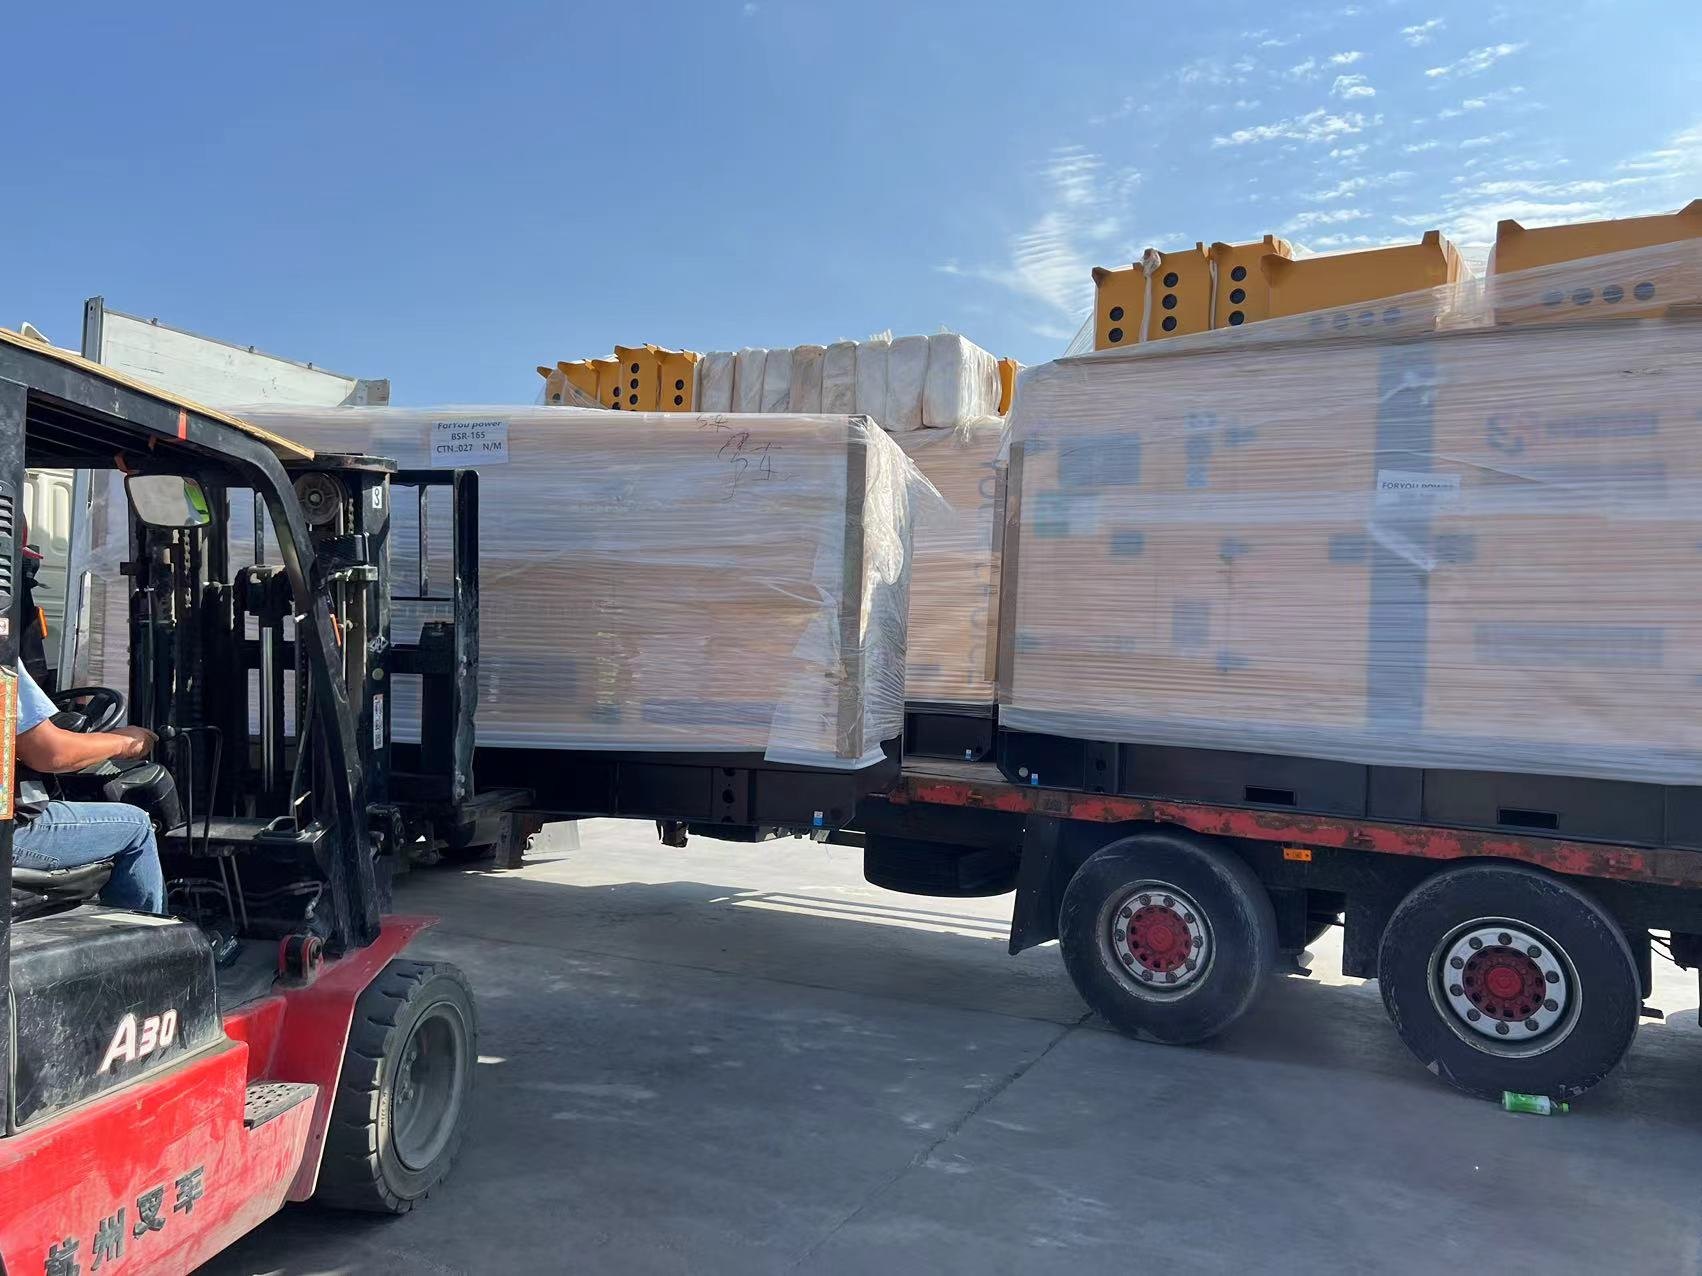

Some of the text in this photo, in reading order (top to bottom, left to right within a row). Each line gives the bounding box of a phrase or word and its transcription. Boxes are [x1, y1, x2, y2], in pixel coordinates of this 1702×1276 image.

[451, 431, 486, 441] BSR-165
[482, 441, 502, 451] N/M
[96, 1008, 178, 1074] A30
